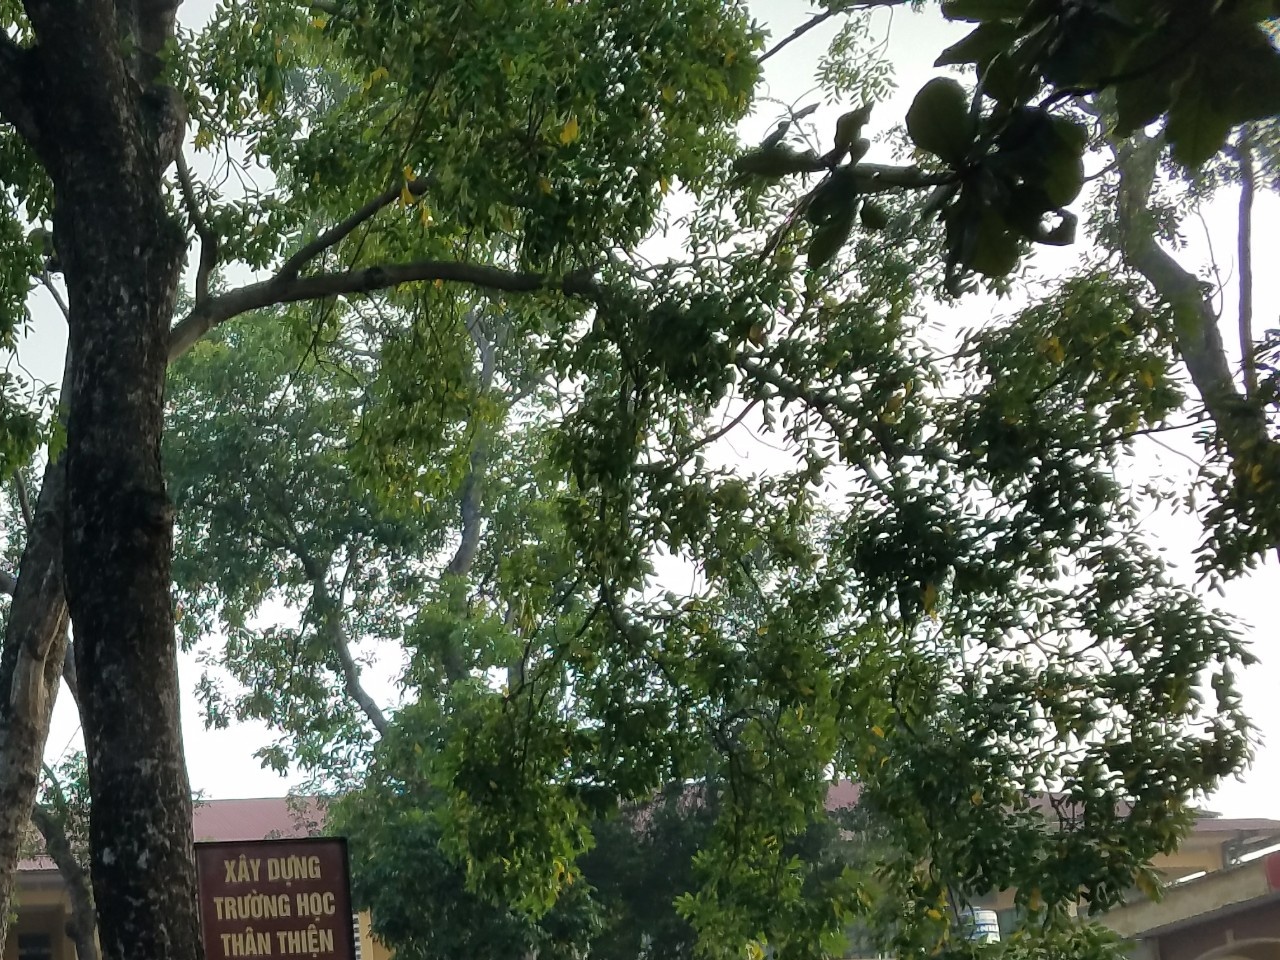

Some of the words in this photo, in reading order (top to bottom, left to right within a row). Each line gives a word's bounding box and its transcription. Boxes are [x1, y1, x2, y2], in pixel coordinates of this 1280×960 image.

[224, 854, 261, 883] XÂY
[267, 855, 321, 887] DỰNG
[214, 889, 291, 920] TRƯỜNG
[297, 892, 336, 922] HỌC
[221, 926, 272, 957] THÂN
[277, 923, 334, 958] THIỆN
